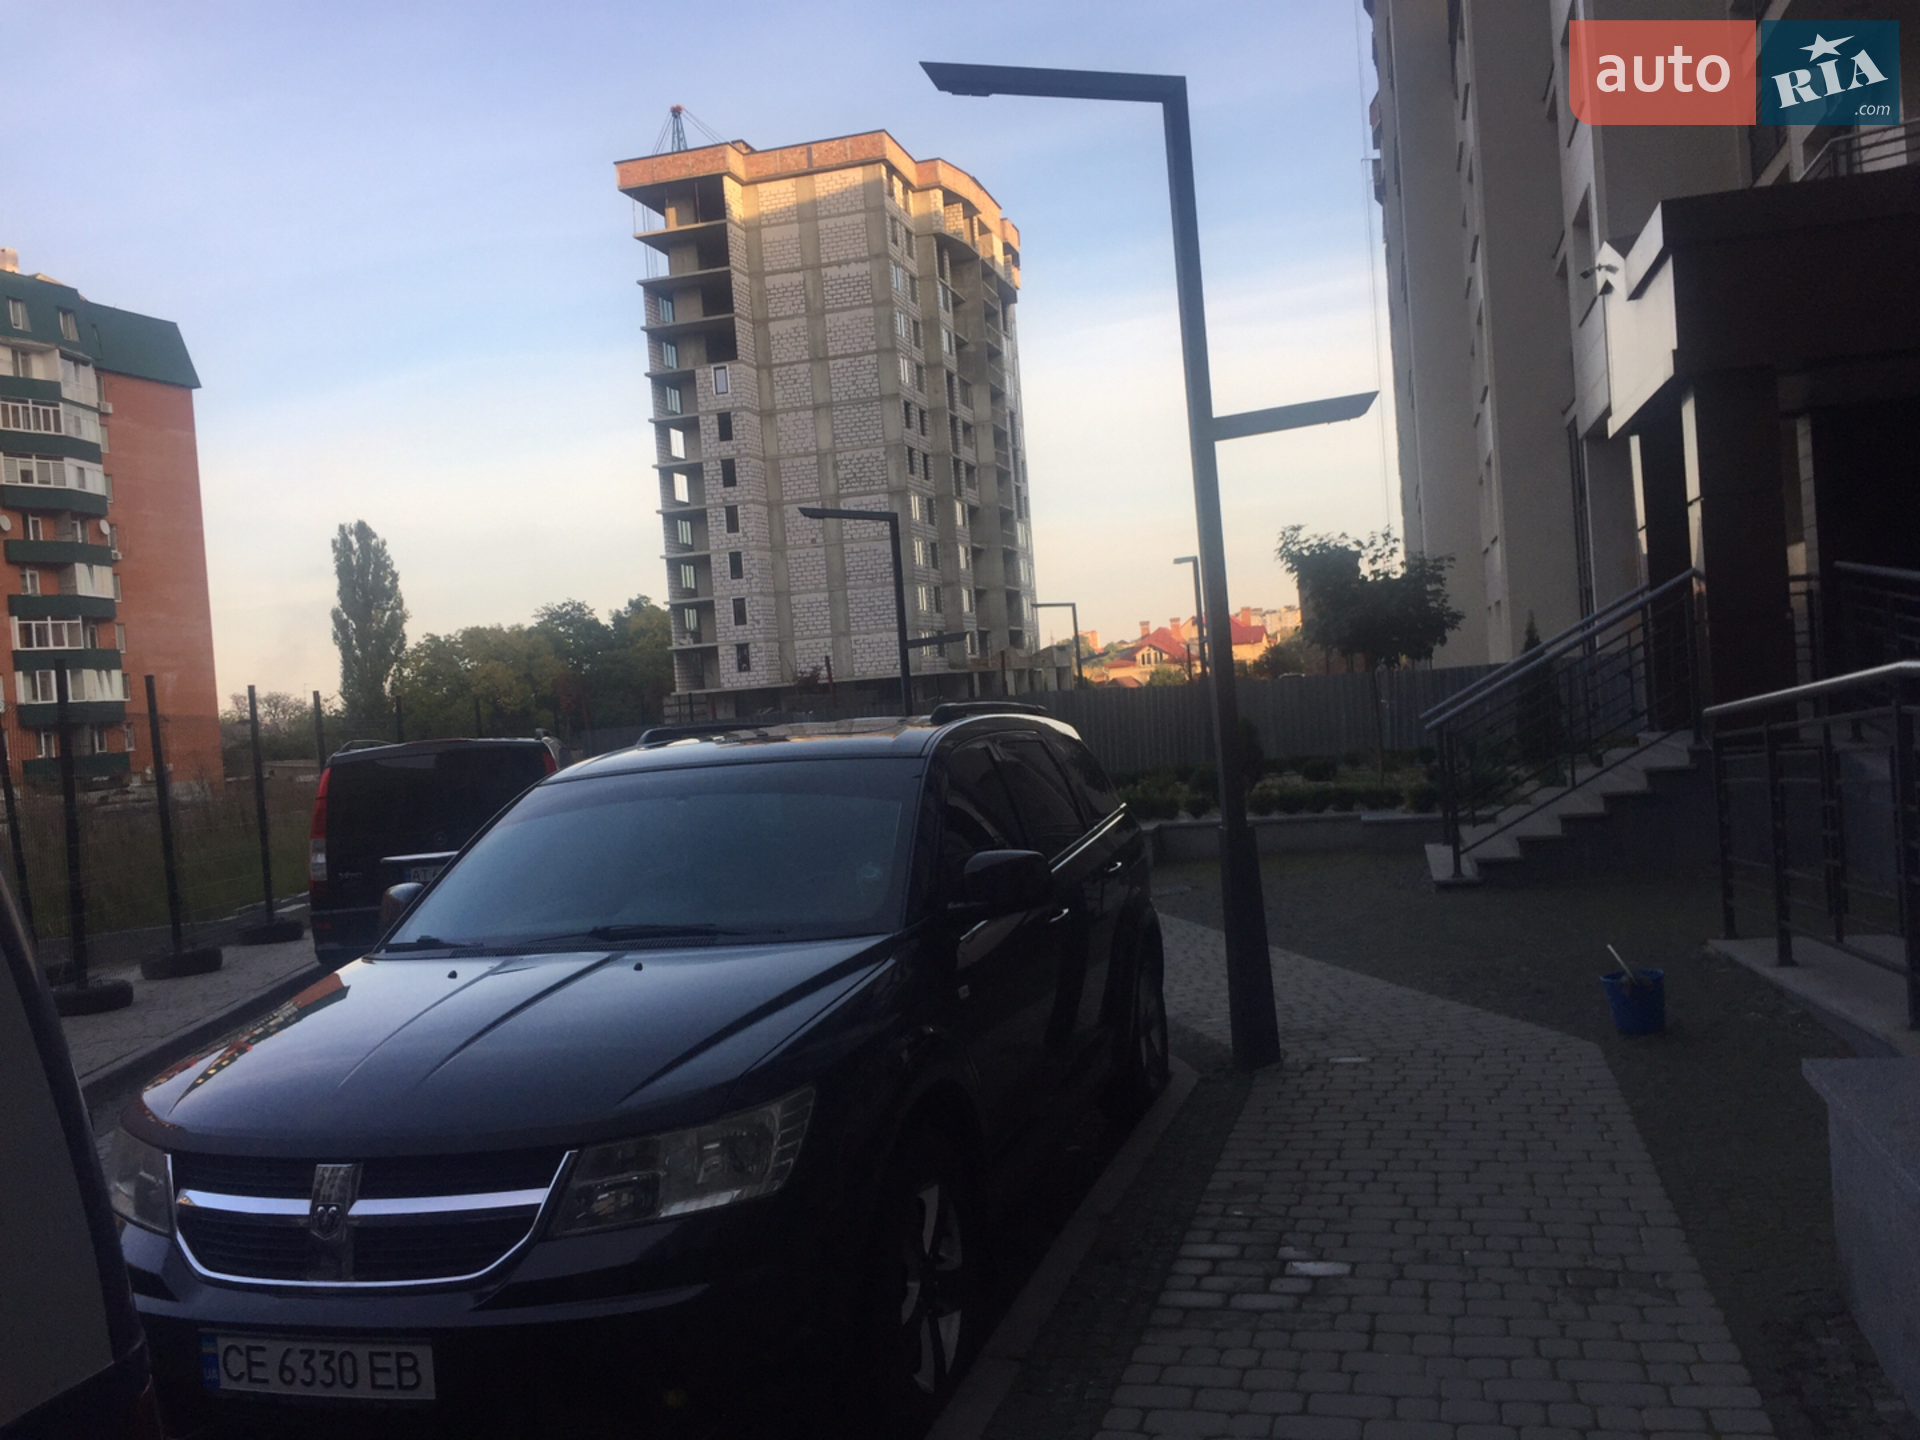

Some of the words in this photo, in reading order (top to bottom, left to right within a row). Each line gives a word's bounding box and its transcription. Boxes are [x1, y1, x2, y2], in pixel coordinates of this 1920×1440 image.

[222, 1344, 269, 1384] CE
[278, 1347, 358, 1389] 6330
[368, 1351, 422, 1391] EB
